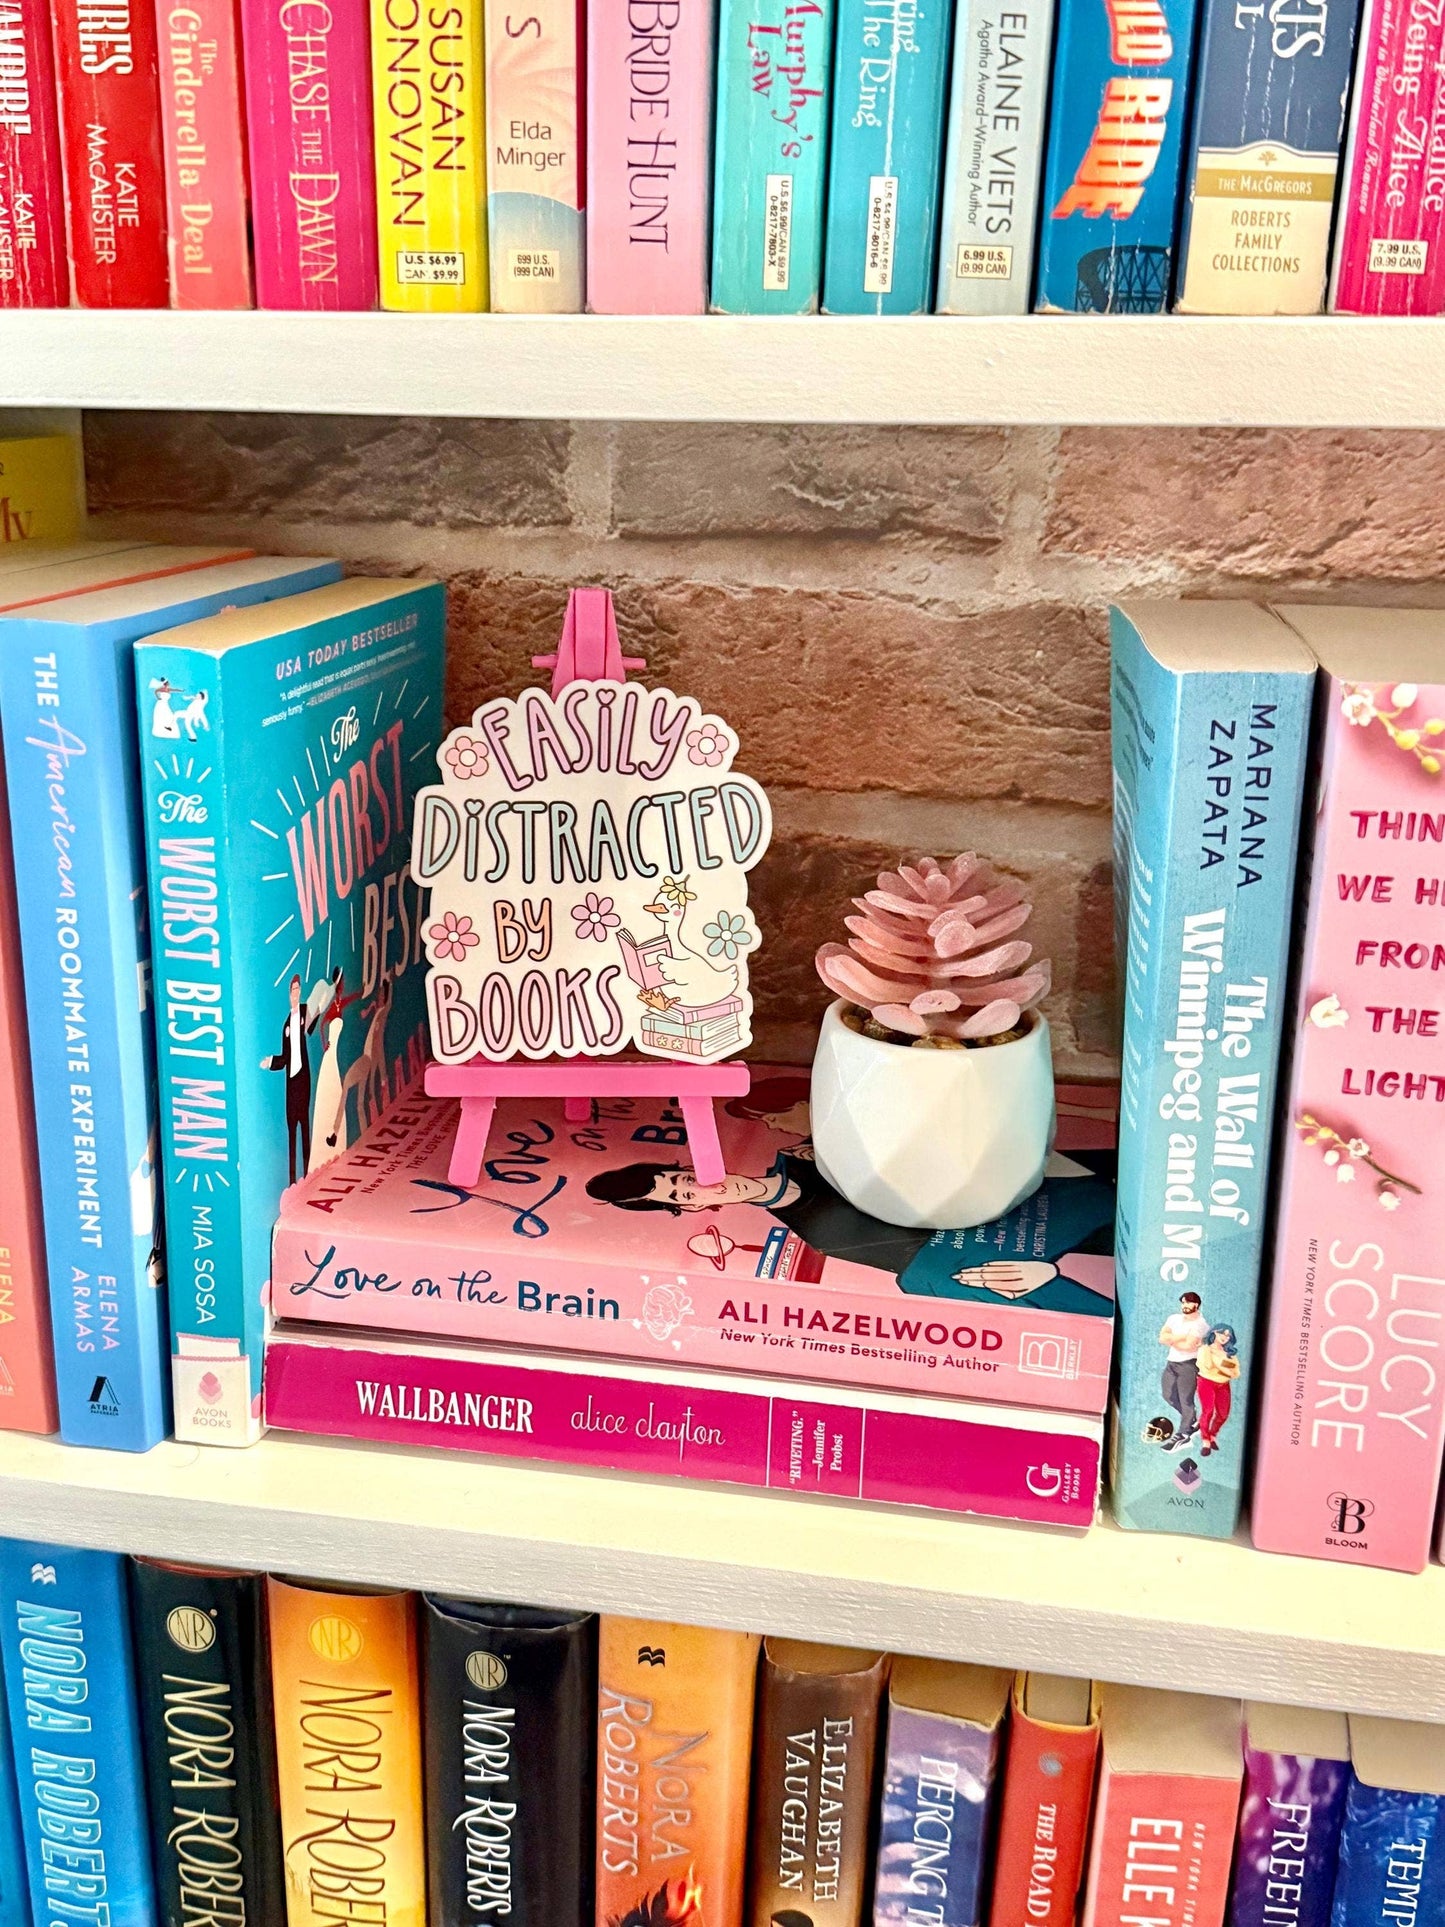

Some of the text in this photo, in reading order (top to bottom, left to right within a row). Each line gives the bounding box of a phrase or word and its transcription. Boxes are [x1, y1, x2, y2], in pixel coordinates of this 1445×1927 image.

[199, 39, 214, 75] The
[747, 22, 783, 99] Law
[977, 19, 994, 68] Agatha
[429, 7, 466, 172] SUSAN
[852, 57, 896, 128] Ring
[985, 12, 1027, 235] ELAINE VIETS
[1386, 0, 1444, 208] Being Alice
[168, 8, 213, 276] Cinderella Deal
[279, 0, 340, 286] CHASE THE DAWN
[495, 147, 567, 172] Minger
[509, 120, 553, 141] Elda
[624, 0, 681, 255] BRIDE HUNT
[1359, 65, 1390, 214] Wonderland Romance
[115, 162, 140, 228] KATIE
[967, 182, 982, 227] Author
[1218, 178, 1237, 189] THE
[15, 193, 37, 249] KATIE
[1231, 210, 1291, 228] ROBERTS
[1234, 233, 1282, 251] FAMILY
[1377, 243, 1421, 255] 7.99 U.S.
[405, 255, 457, 266] U.S. $6.99
[433, 270, 459, 280] $9.99
[532, 267, 555, 279] CAN)
[533, 254, 550, 265] U.S.
[960, 263, 1007, 276] (9.99 CAN)
[963, 251, 1006, 262] 6.99 U.S.
[1212, 254, 1301, 273] COLLECTIONS
[275, 655, 302, 680] USA
[307, 639, 348, 669] TODAY
[352, 613, 419, 651] BESTSELLER
[331, 705, 360, 763] The
[481, 688, 691, 792] EASILY
[1199, 719, 1236, 871] ZAPATA
[1236, 704, 1278, 888] MARIANA
[286, 719, 404, 942] WORST
[419, 782, 763, 885] DISTRACTED
[1337, 872, 1395, 904] WE
[26, 652, 103, 1249] THE American ROOMMATE EXPERIMENT
[493, 897, 552, 963] BY
[157, 790, 229, 1162] The WORST BEST MAN
[433, 965, 624, 1057] BOOKS
[1365, 1006, 1440, 1037] THE
[1159, 907, 1227, 1283] Winnipeg and Me
[1209, 976, 1269, 1227] The Wall of
[1341, 1068, 1445, 1102] LIGHT
[360, 1177, 385, 1194] New
[380, 1160, 402, 1179] York
[405, 1134, 445, 1170] THE LOVE
[409, 1118, 568, 1239] Love
[306, 1176, 362, 1214] ALI
[191, 1205, 217, 1325] MIA SOSA
[289, 1245, 621, 1321] Love on the Brain
[71, 1266, 95, 1353] ARMAS
[98, 1275, 121, 1351] ELENA
[718, 1299, 1004, 1353] ALI HAZELWOOD
[1290, 1238, 1318, 1447] NEW YORK TIMES BESTSELLING AUTHOR
[719, 1328, 1000, 1374] New York Times Bestselling Author
[1066, 1339, 1080, 1380] BERKLEY
[1310, 1239, 1385, 1453] SCORE
[1376, 1271, 1445, 1441] LUCY
[90, 1404, 119, 1412] ATRIA
[192, 1416, 231, 1429] BOOKS
[195, 1407, 228, 1418] AVON
[355, 1380, 726, 1463] WALLBANGER alice clayton
[830, 1433, 843, 1472] Probst
[1062, 1462, 1072, 1503] GALLERY
[1072, 1467, 1081, 1499] BOOKS
[1166, 1496, 1205, 1508] AVON
[1325, 1537, 1369, 1551] BLOOM
[16, 1599, 111, 1927] NORA ROBERT
[162, 1673, 237, 1788] NORA
[299, 1679, 393, 1791] NORA
[451, 1699, 517, 1915] NORA ROBERTS
[599, 1686, 653, 1877] ROBERTS
[651, 1731, 709, 1863] NORA
[779, 1730, 817, 1892] VAUGHAN
[813, 1716, 854, 1903] ELIZABETH
[907, 1755, 959, 1899] PIERCING
[1026, 1803, 1058, 1918] THE ROAD
[1122, 1817, 1183, 1905] ELLE
[1188, 1822, 1206, 1891] NEW YORK
